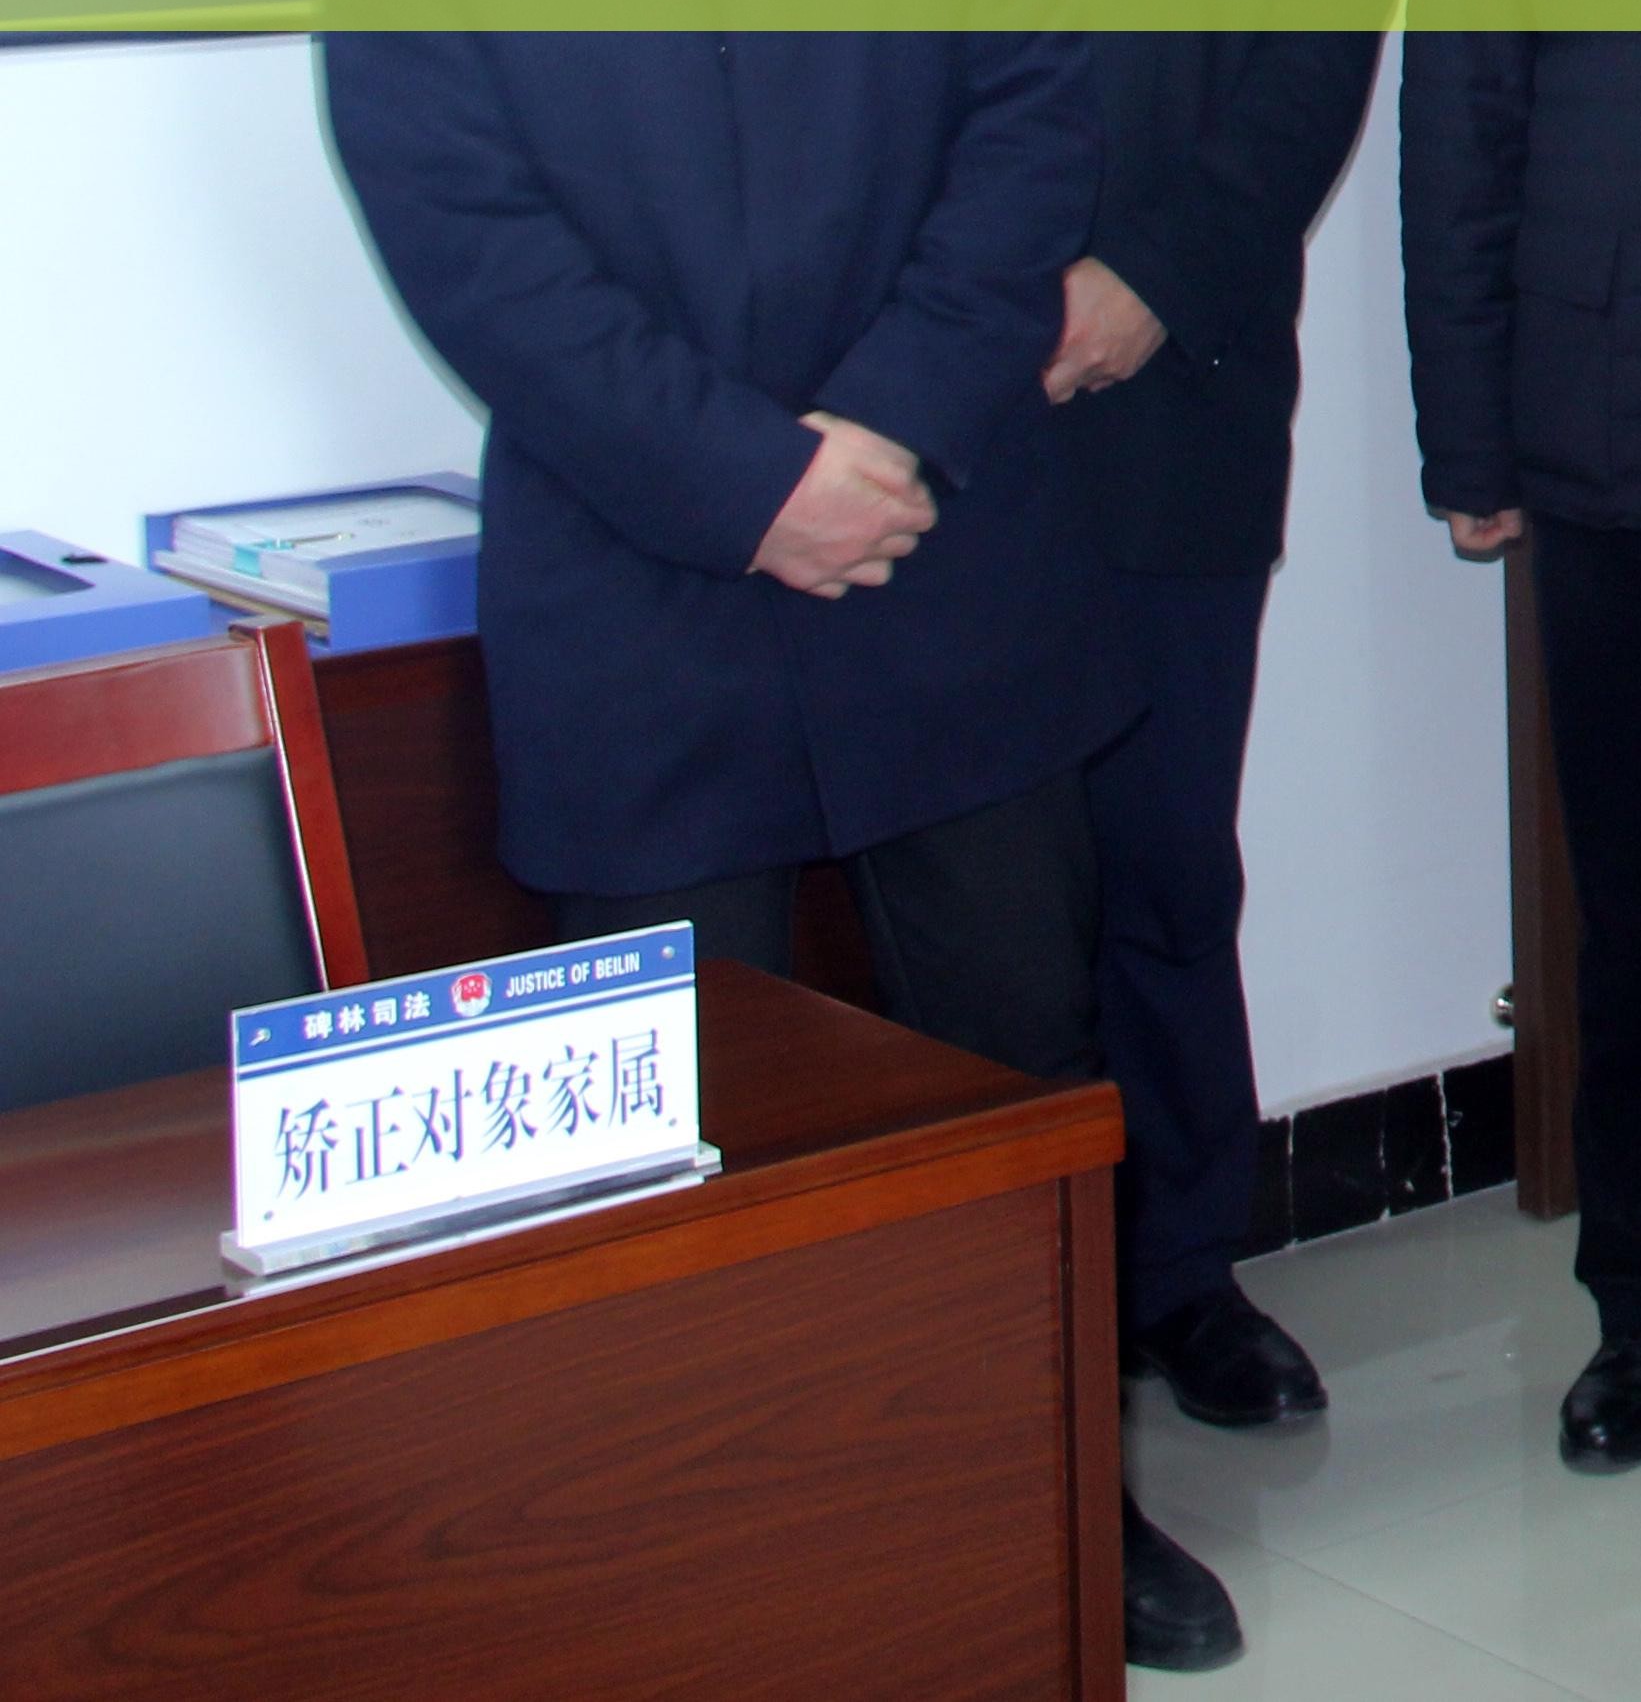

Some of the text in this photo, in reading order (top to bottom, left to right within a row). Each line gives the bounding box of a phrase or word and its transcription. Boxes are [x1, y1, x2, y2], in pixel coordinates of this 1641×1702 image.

[505, 951, 641, 998] JUSTICE OF BEILIN
[303, 991, 432, 1041] 碑林司法
[275, 1029, 664, 1200] 矫正对象家属
